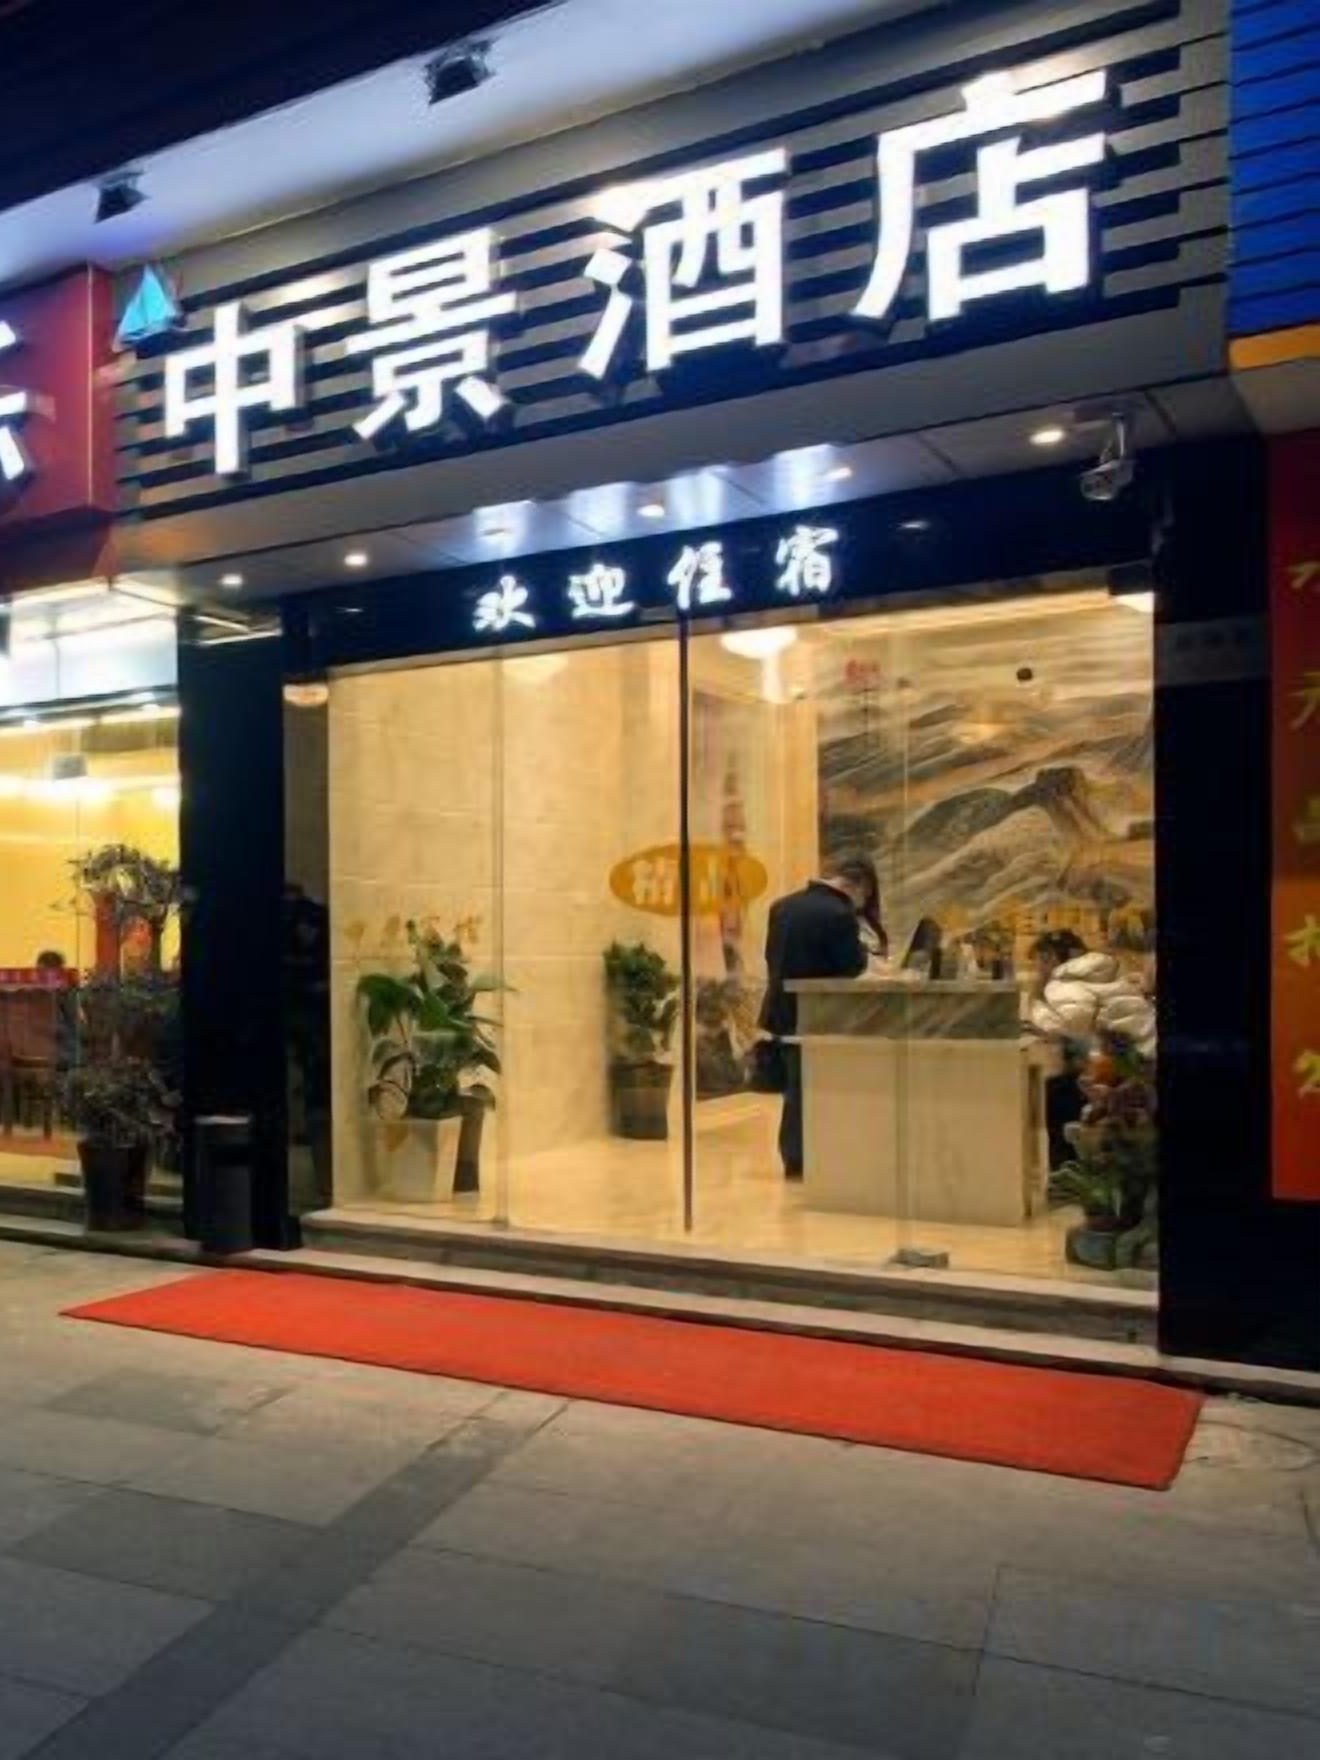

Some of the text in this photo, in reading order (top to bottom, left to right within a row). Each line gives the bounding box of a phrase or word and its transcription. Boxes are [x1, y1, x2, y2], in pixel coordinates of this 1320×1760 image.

[165, 68, 1107, 477] 中景酒店
[473, 525, 838, 631] 欢迎住宿
